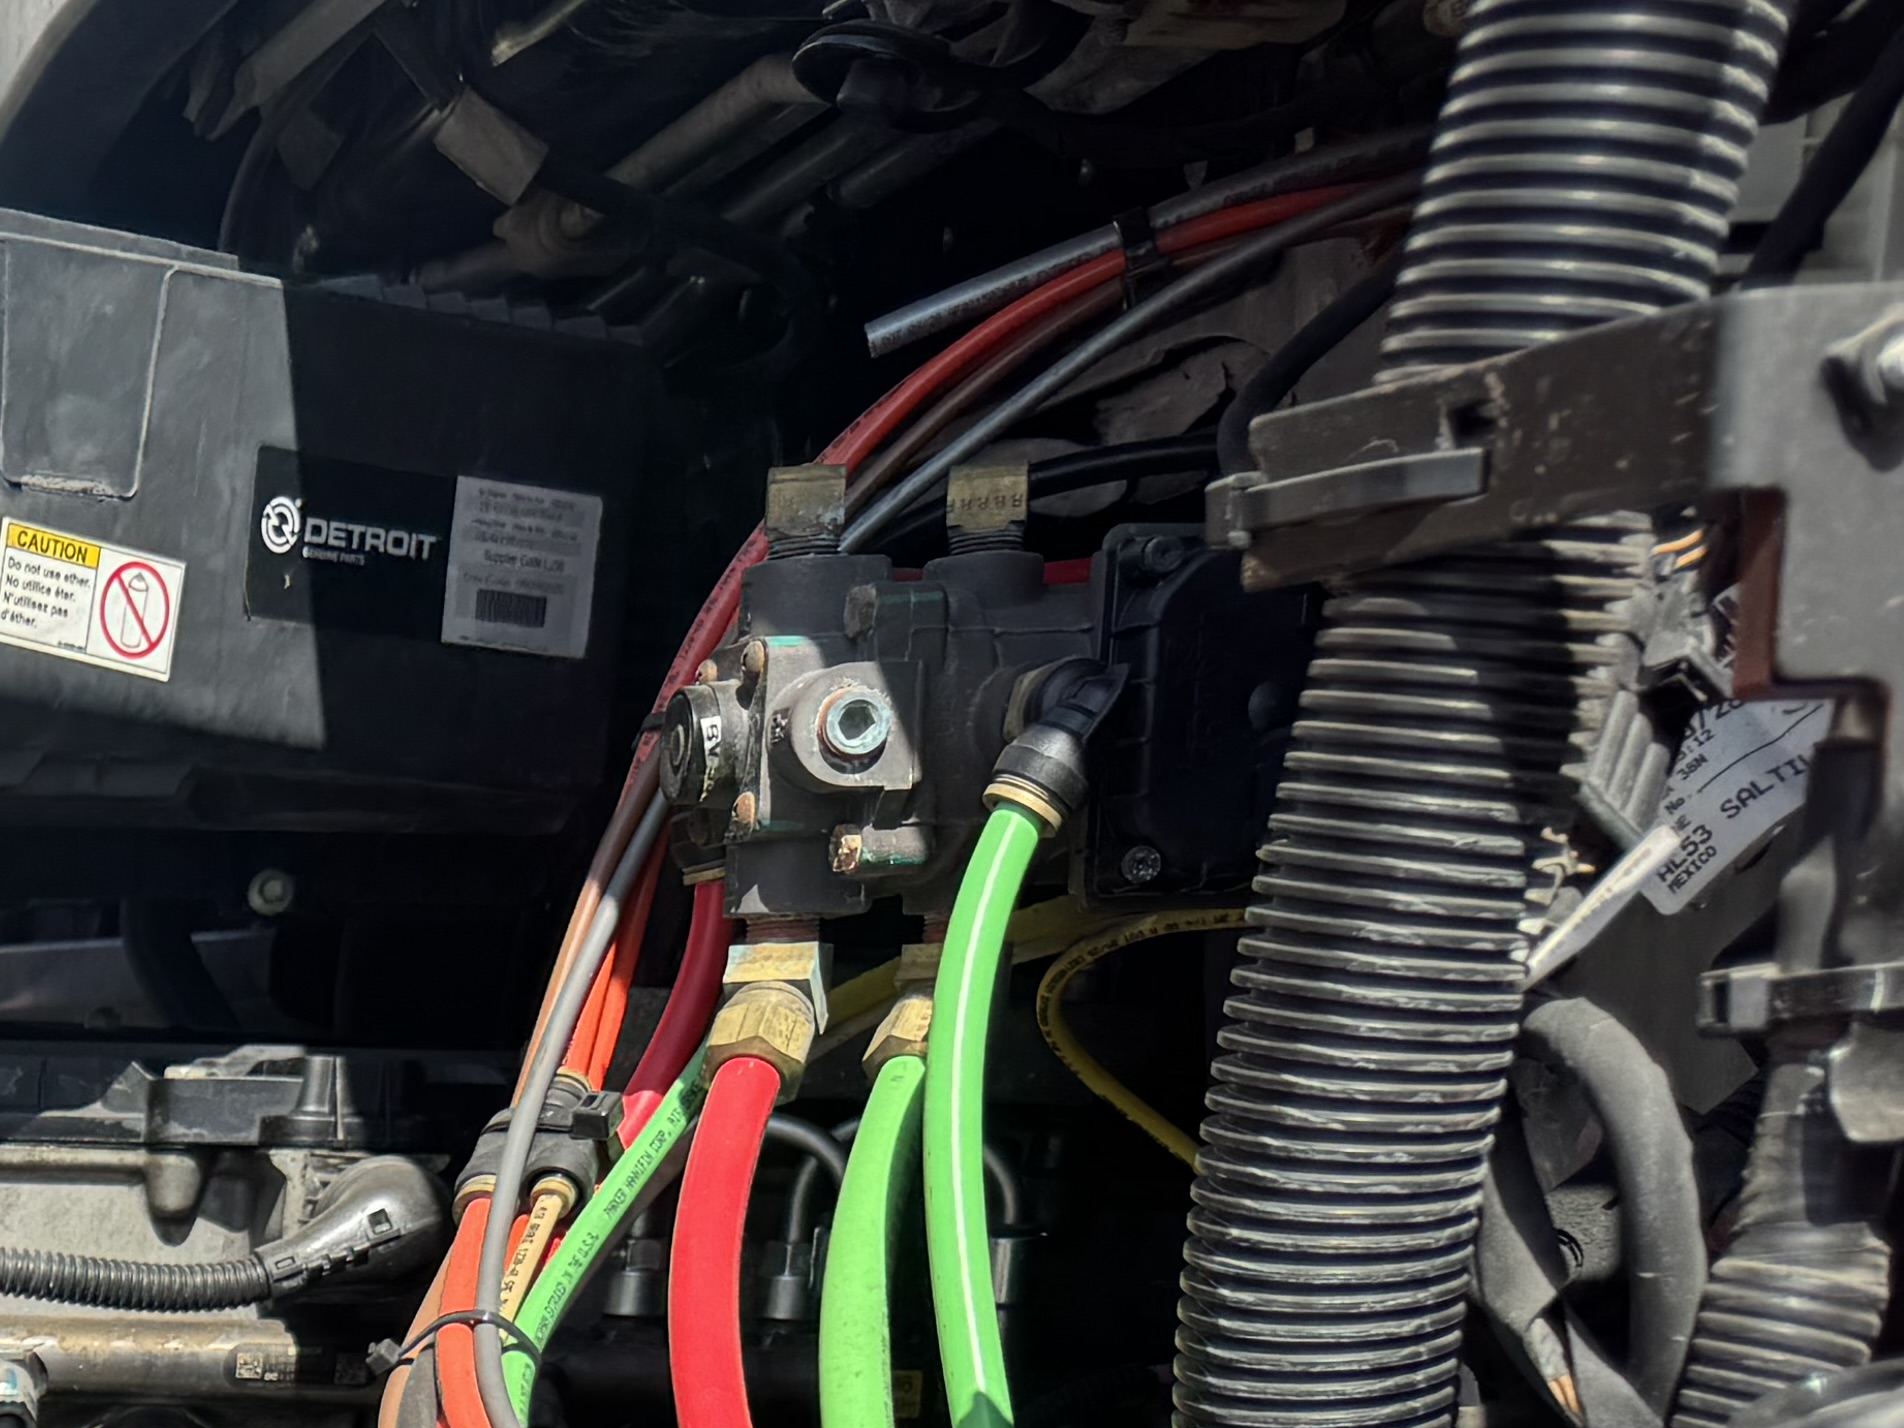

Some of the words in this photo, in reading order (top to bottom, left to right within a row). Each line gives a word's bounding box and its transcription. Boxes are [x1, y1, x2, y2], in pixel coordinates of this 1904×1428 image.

[17, 530, 88, 563] CAUTION
[304, 517, 437, 562] DETROIT
[8, 556, 22, 570] Do
[24, 562, 41, 575] not
[43, 568, 61, 580] use
[6, 575, 19, 588] No
[22, 577, 51, 594] utilice
[50, 605, 69, 619] pas
[1667, 844, 1718, 895] MEXICO
